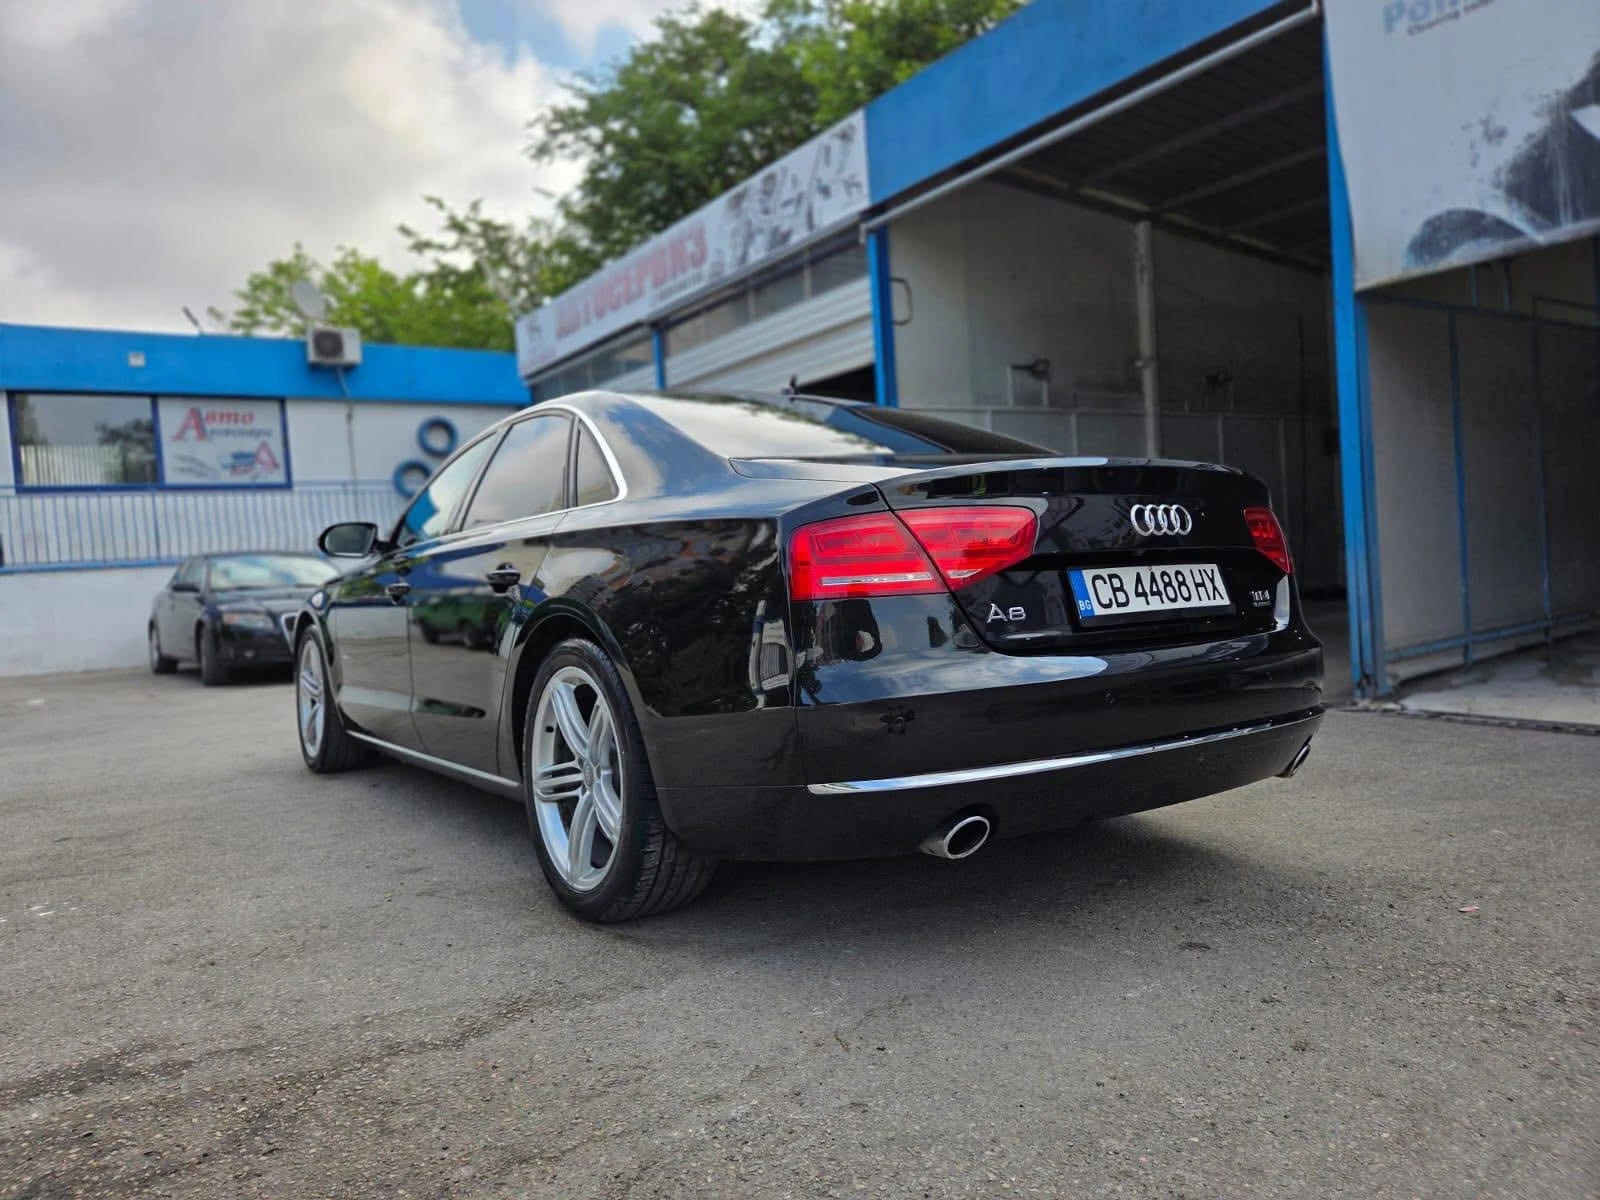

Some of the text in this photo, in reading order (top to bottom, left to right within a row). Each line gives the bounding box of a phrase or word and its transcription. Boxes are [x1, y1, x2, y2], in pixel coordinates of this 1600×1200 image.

[1091, 568, 1225, 609] CB 4488 HX
[986, 603, 1026, 623] A8
[1079, 600, 1092, 610] BG
